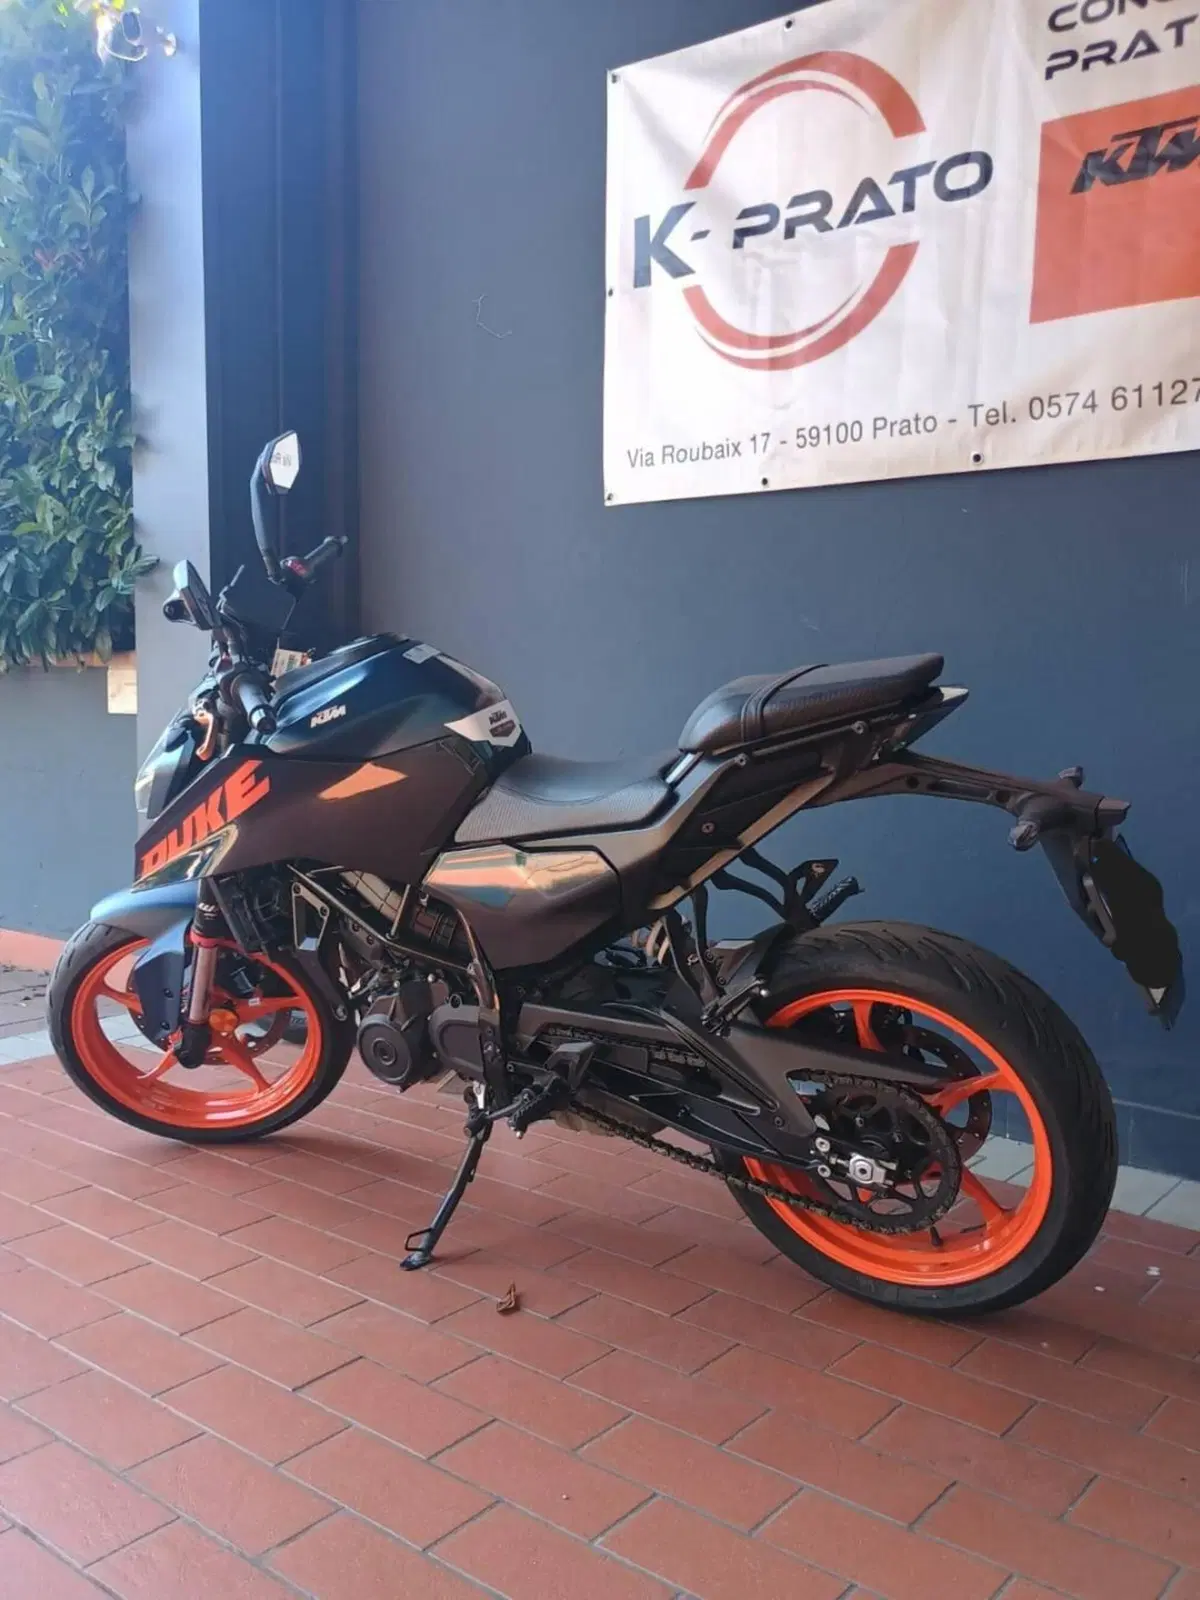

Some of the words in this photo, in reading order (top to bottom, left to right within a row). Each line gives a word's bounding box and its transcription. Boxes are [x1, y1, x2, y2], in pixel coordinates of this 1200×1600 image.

[627, 447, 655, 468] Via
[661, 437, 742, 464] Roubaix
[749, 432, 771, 454] 17
[795, 420, 863, 449] 59100
[872, 413, 938, 440] Prato
[967, 401, 1017, 427] Tel.
[1029, 390, 1099, 421] 0574
[310, 705, 347, 729] KTM
[140, 759, 270, 880] DUKE
